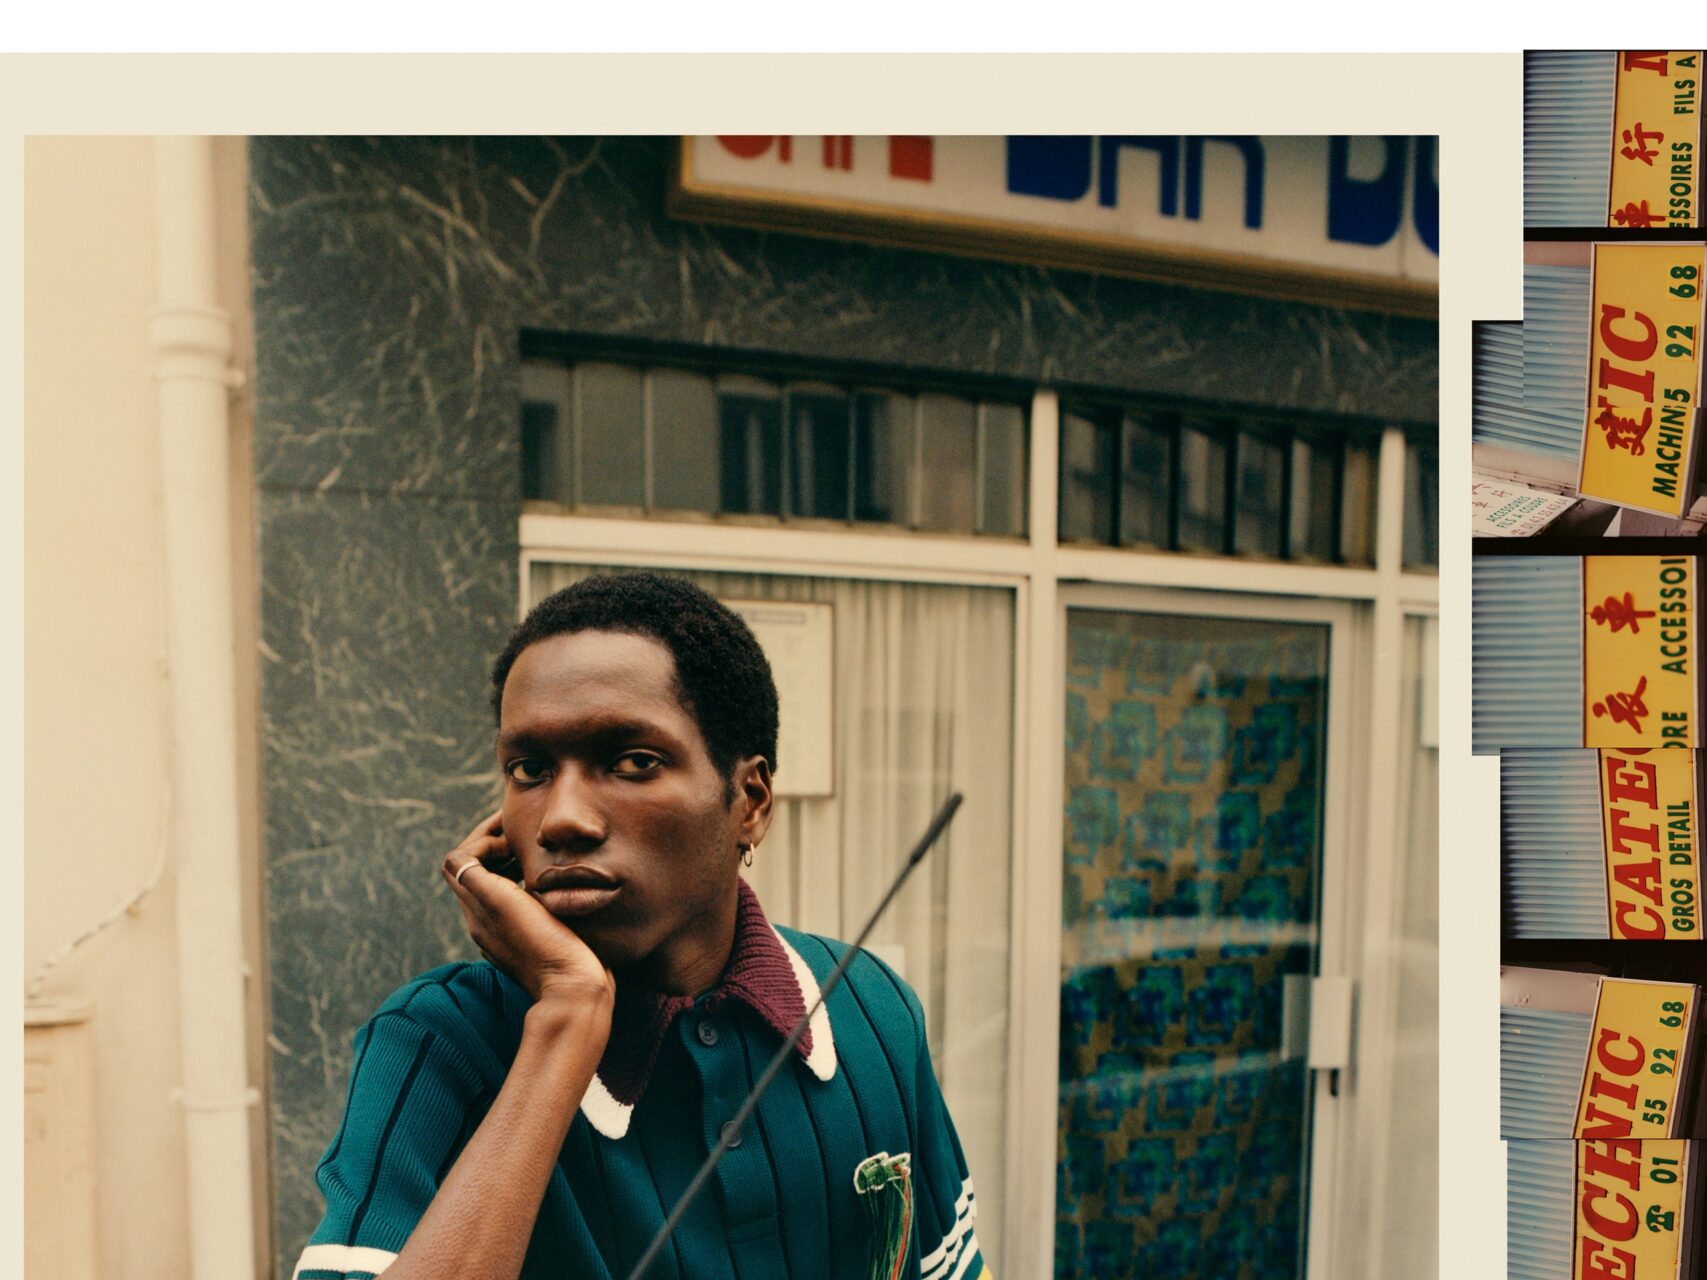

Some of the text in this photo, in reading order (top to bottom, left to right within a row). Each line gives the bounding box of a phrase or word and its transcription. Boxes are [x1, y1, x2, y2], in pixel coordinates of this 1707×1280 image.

[1675, 55, 1697, 68] A
[1673, 79, 1696, 115] FILS
[1668, 265, 1698, 298] 68
[1664, 324, 1694, 358] 92
[1660, 558, 1687, 675] ACCESSOI
[1606, 748, 1666, 940] CATE
[1666, 801, 1695, 932] GROS DETAIL
[1642, 1001, 1685, 1125] 55 92 68
[1649, 1156, 1678, 1184] 01
